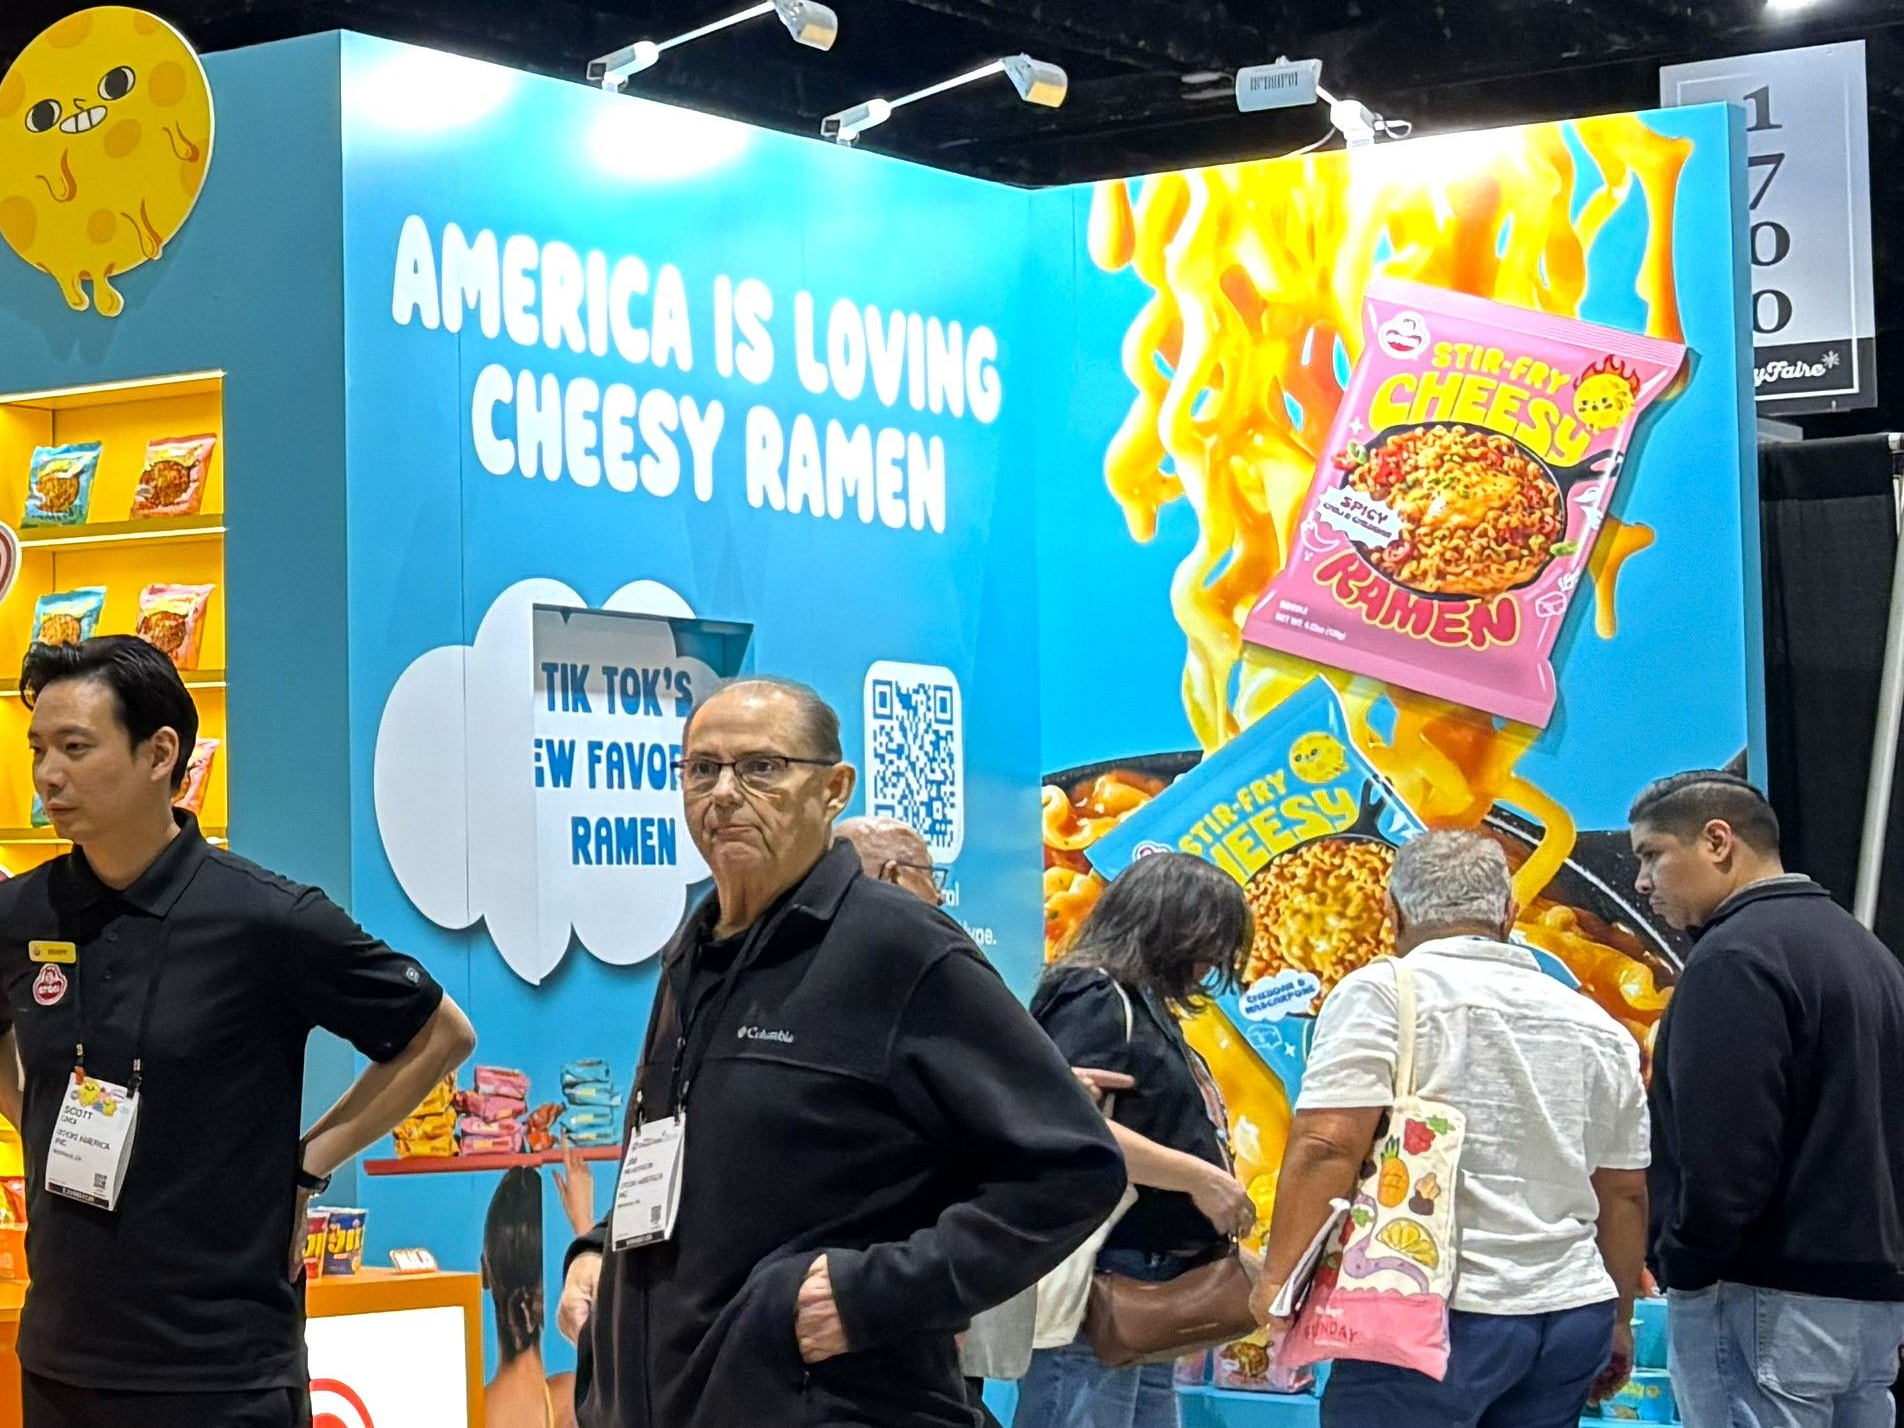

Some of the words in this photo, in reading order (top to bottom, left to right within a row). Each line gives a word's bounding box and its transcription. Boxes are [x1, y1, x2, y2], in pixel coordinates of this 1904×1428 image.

[1743, 85, 1793, 334] 1700
[391, 213, 694, 375] AMERICA
[713, 273, 774, 383] IS
[793, 289, 1000, 425] LOVING
[1431, 341, 1572, 396] STIR-FRY
[471, 363, 725, 502] CHEESY
[745, 403, 948, 534] RAMEN
[1368, 370, 1591, 468] CHEESY
[1340, 496, 1389, 525] SPICY
[1312, 548, 1521, 652] RAMEN
[542, 662, 592, 714] TIK
[602, 666, 694, 718] TOK'S
[534, 738, 576, 789] EW
[571, 815, 677, 866] RAMEN
[1179, 769, 1289, 856] STIR-FRY
